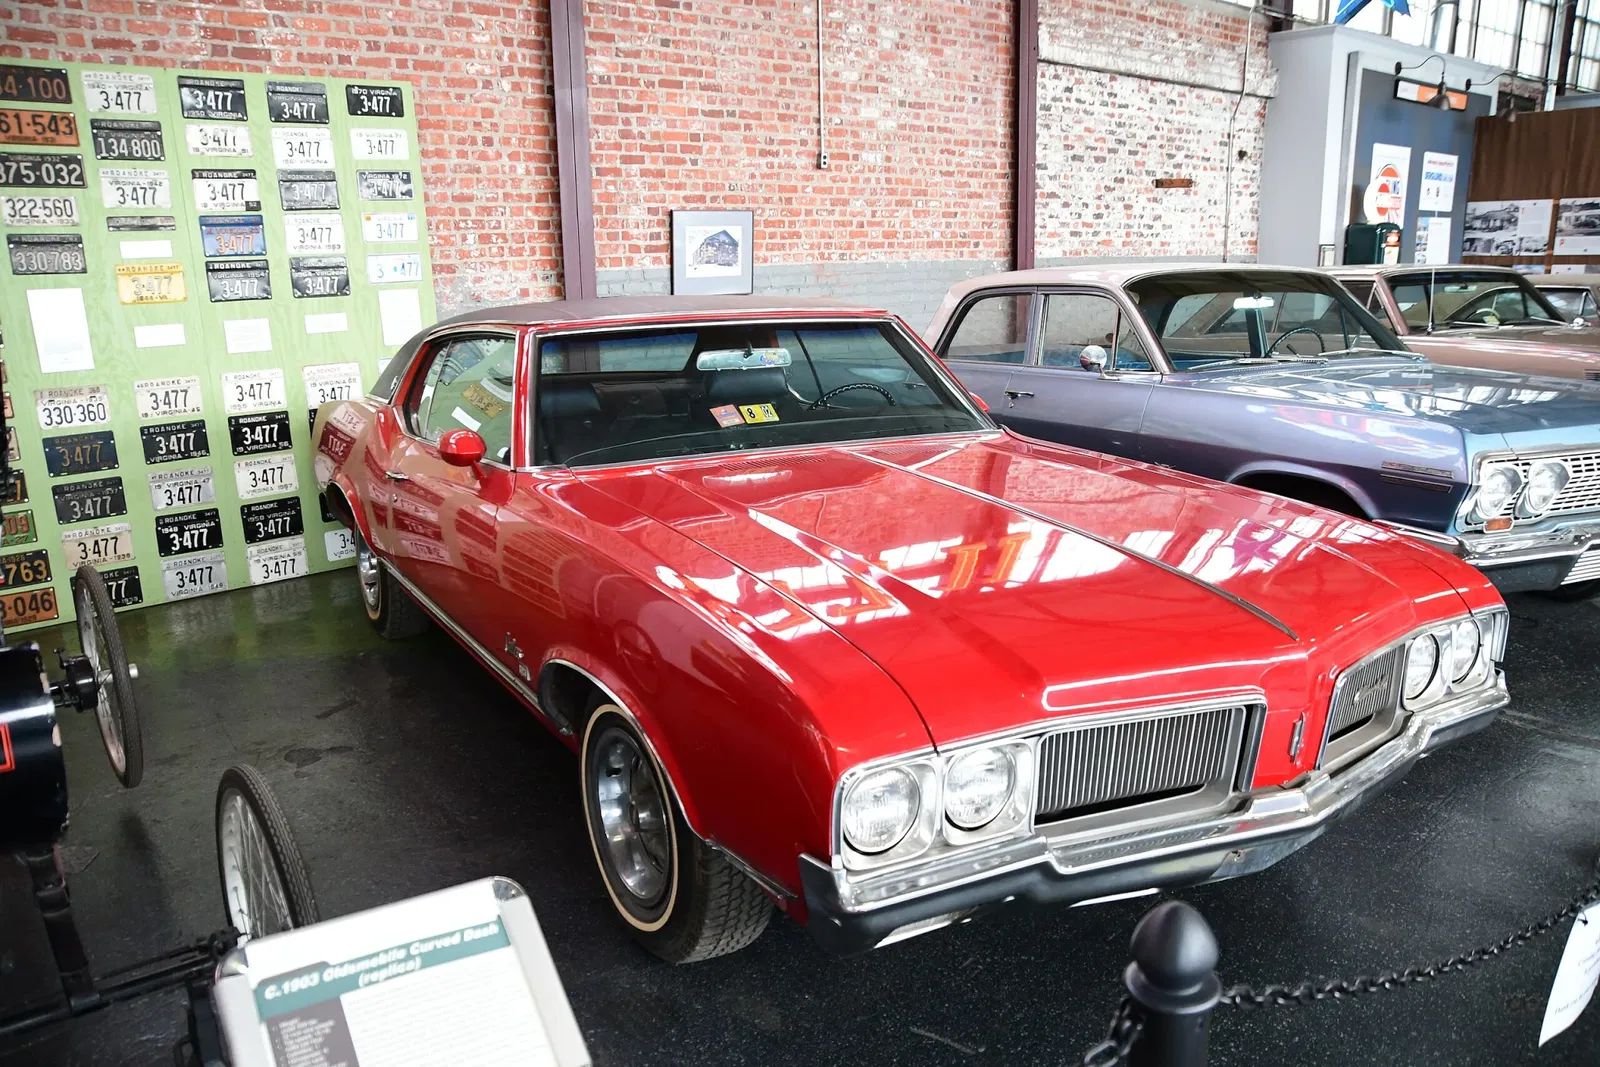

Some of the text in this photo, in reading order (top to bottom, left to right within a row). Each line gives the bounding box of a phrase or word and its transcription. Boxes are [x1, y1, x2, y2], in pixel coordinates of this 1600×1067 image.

[93, 73, 134, 82] ROANOKE
[110, 169, 149, 178] ROANOKE
[126, 265, 164, 273] ROANOKE
[233, 372, 261, 380] ROANOKE
[144, 378, 182, 387] ROANOKE
[318, 378, 347, 388] VIRGINIA
[48, 387, 84, 398] ROANOKE
[41, 398, 78, 407] VIRGINIA
[252, 399, 282, 408] VIRGINIA
[155, 408, 188, 417] VIRGINIA
[746, 407, 756, 419] 8
[239, 415, 268, 424] ROANOKE
[149, 423, 187, 433] ROANOKE
[245, 442, 276, 451] VIRGINIA
[149, 452, 183, 462] VIRGINIA
[244, 458, 272, 467] ROANOKE
[157, 470, 195, 480] ROANOKE
[64, 480, 104, 491] ROANOKE
[166, 479, 199, 488] VIRGINIA
[246, 486, 274, 496] VIRGINIA
[59, 492, 95, 502] VIRGINIA
[250, 502, 279, 512] ROANOKE
[164, 513, 197, 524] ROANOKE
[266, 509, 296, 519] VIRGINIA
[72, 526, 112, 538] ROANOKE
[161, 520, 216, 534] 1948 VIRGINIA
[256, 544, 283, 555] ROANOKE
[72, 557, 107, 568] VIRGINIA
[173, 556, 206, 567] ROANOKE
[261, 553, 291, 562] VIRGINIA
[170, 586, 203, 597] VIRGINIA
[322, 948, 408, 983] Oldsmobile
[410, 931, 462, 957] Curved
[463, 923, 499, 943] Dash
[357, 956, 423, 989] (replica)
